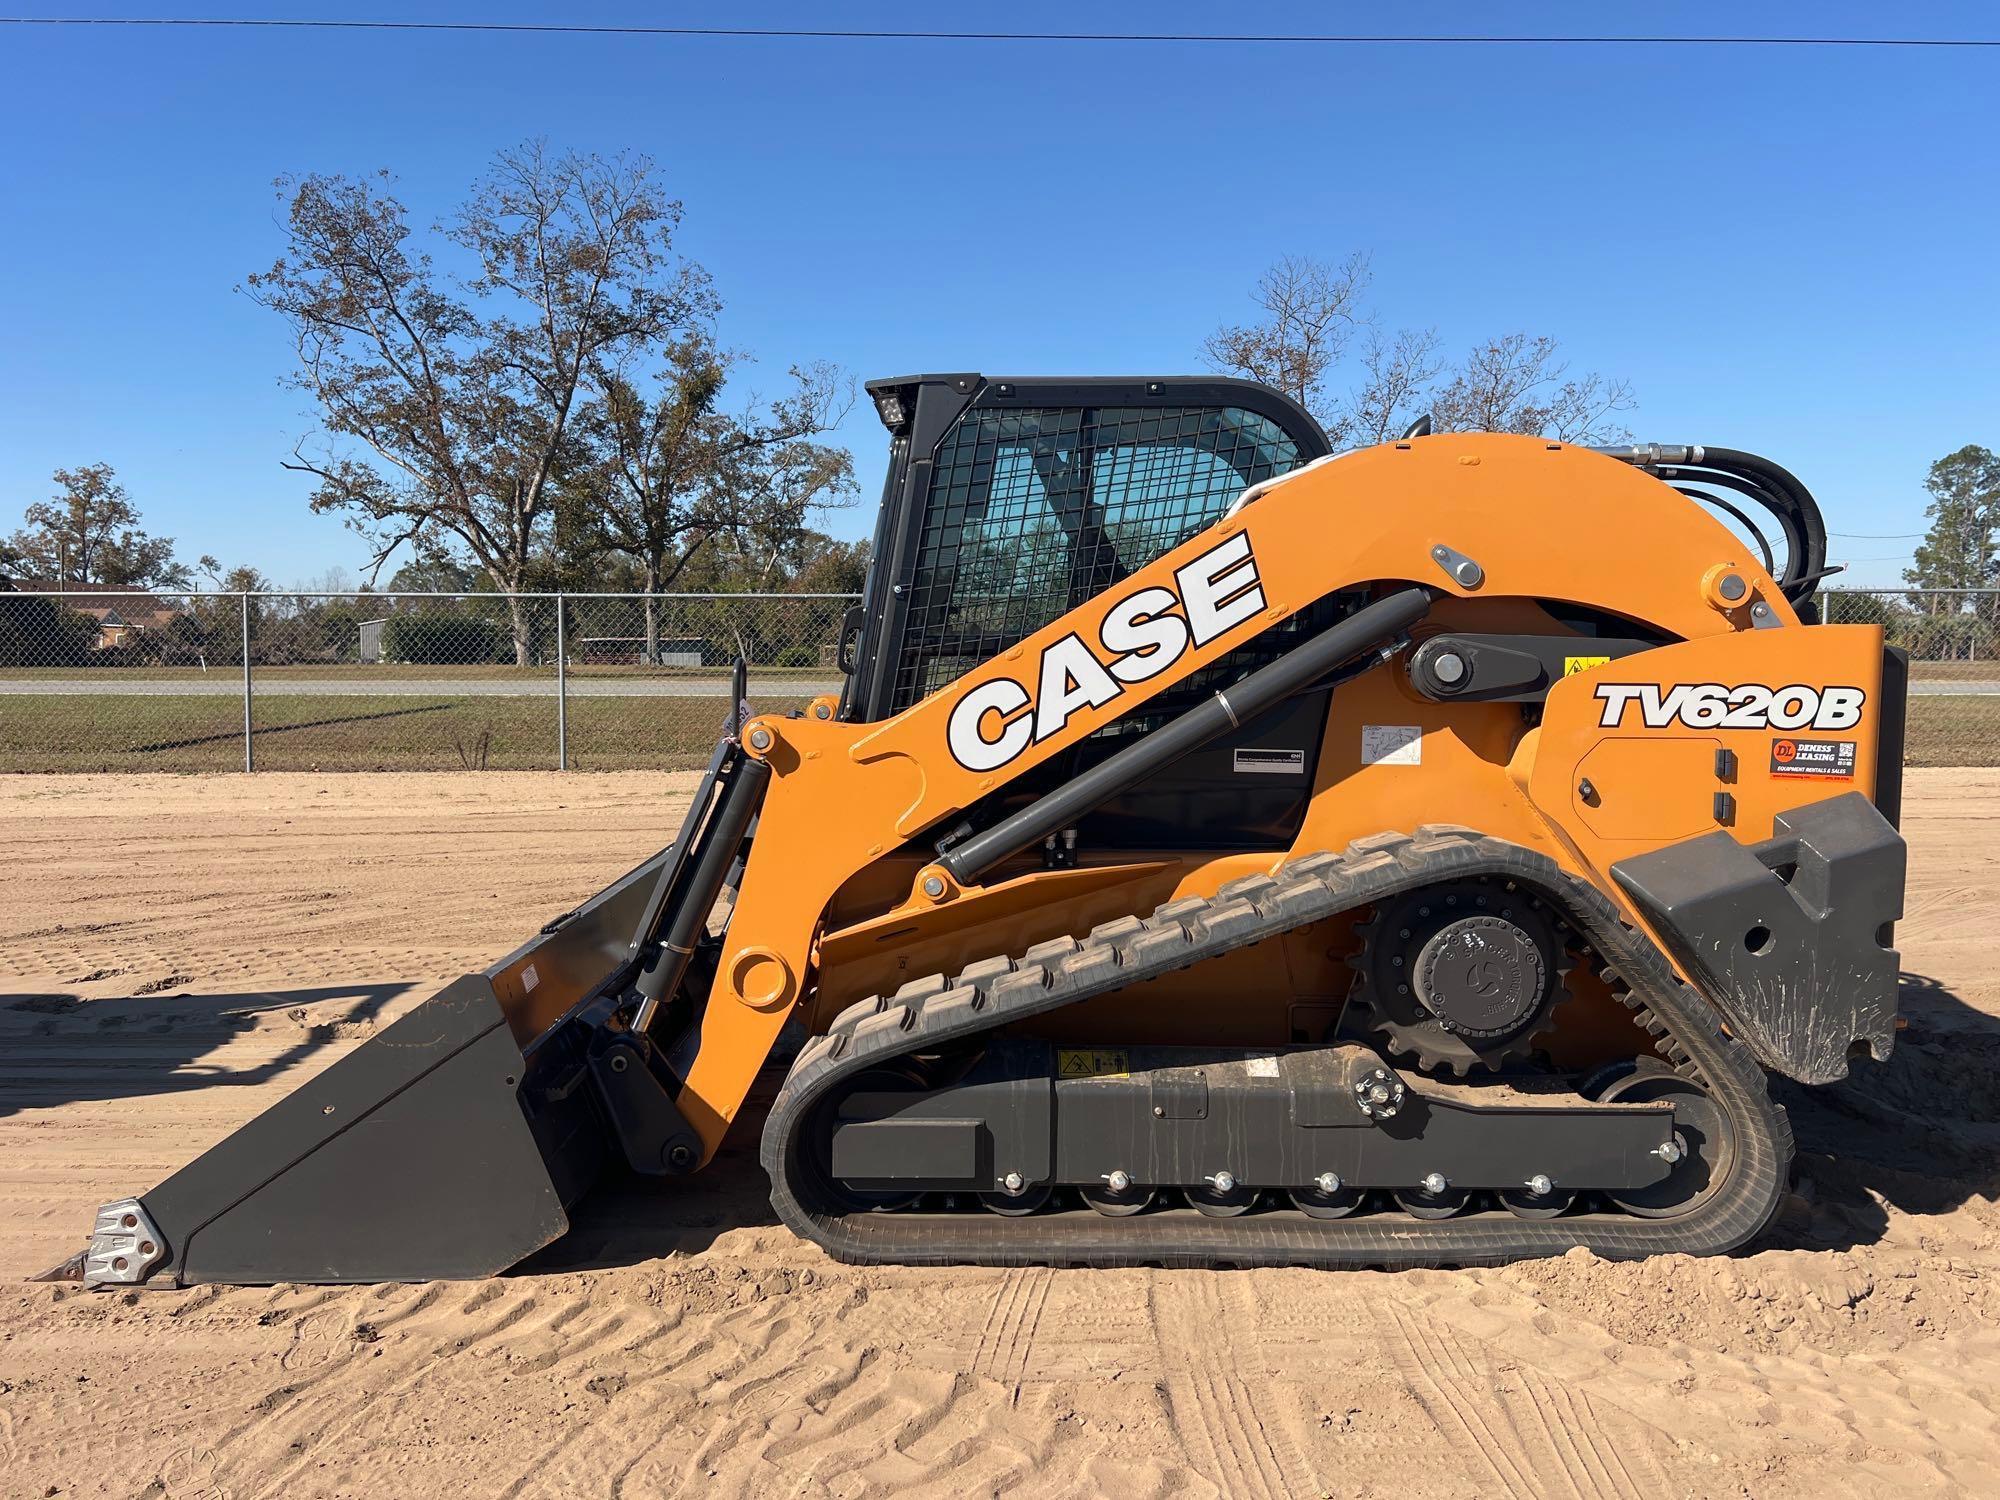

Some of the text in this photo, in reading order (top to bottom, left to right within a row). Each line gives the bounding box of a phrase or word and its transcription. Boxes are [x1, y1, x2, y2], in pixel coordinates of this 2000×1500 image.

[947, 528, 1268, 773] CASE
[1593, 683, 1867, 731] TV620B
[1777, 745, 1793, 756] DL
[1795, 752, 1835, 761] LEASING
